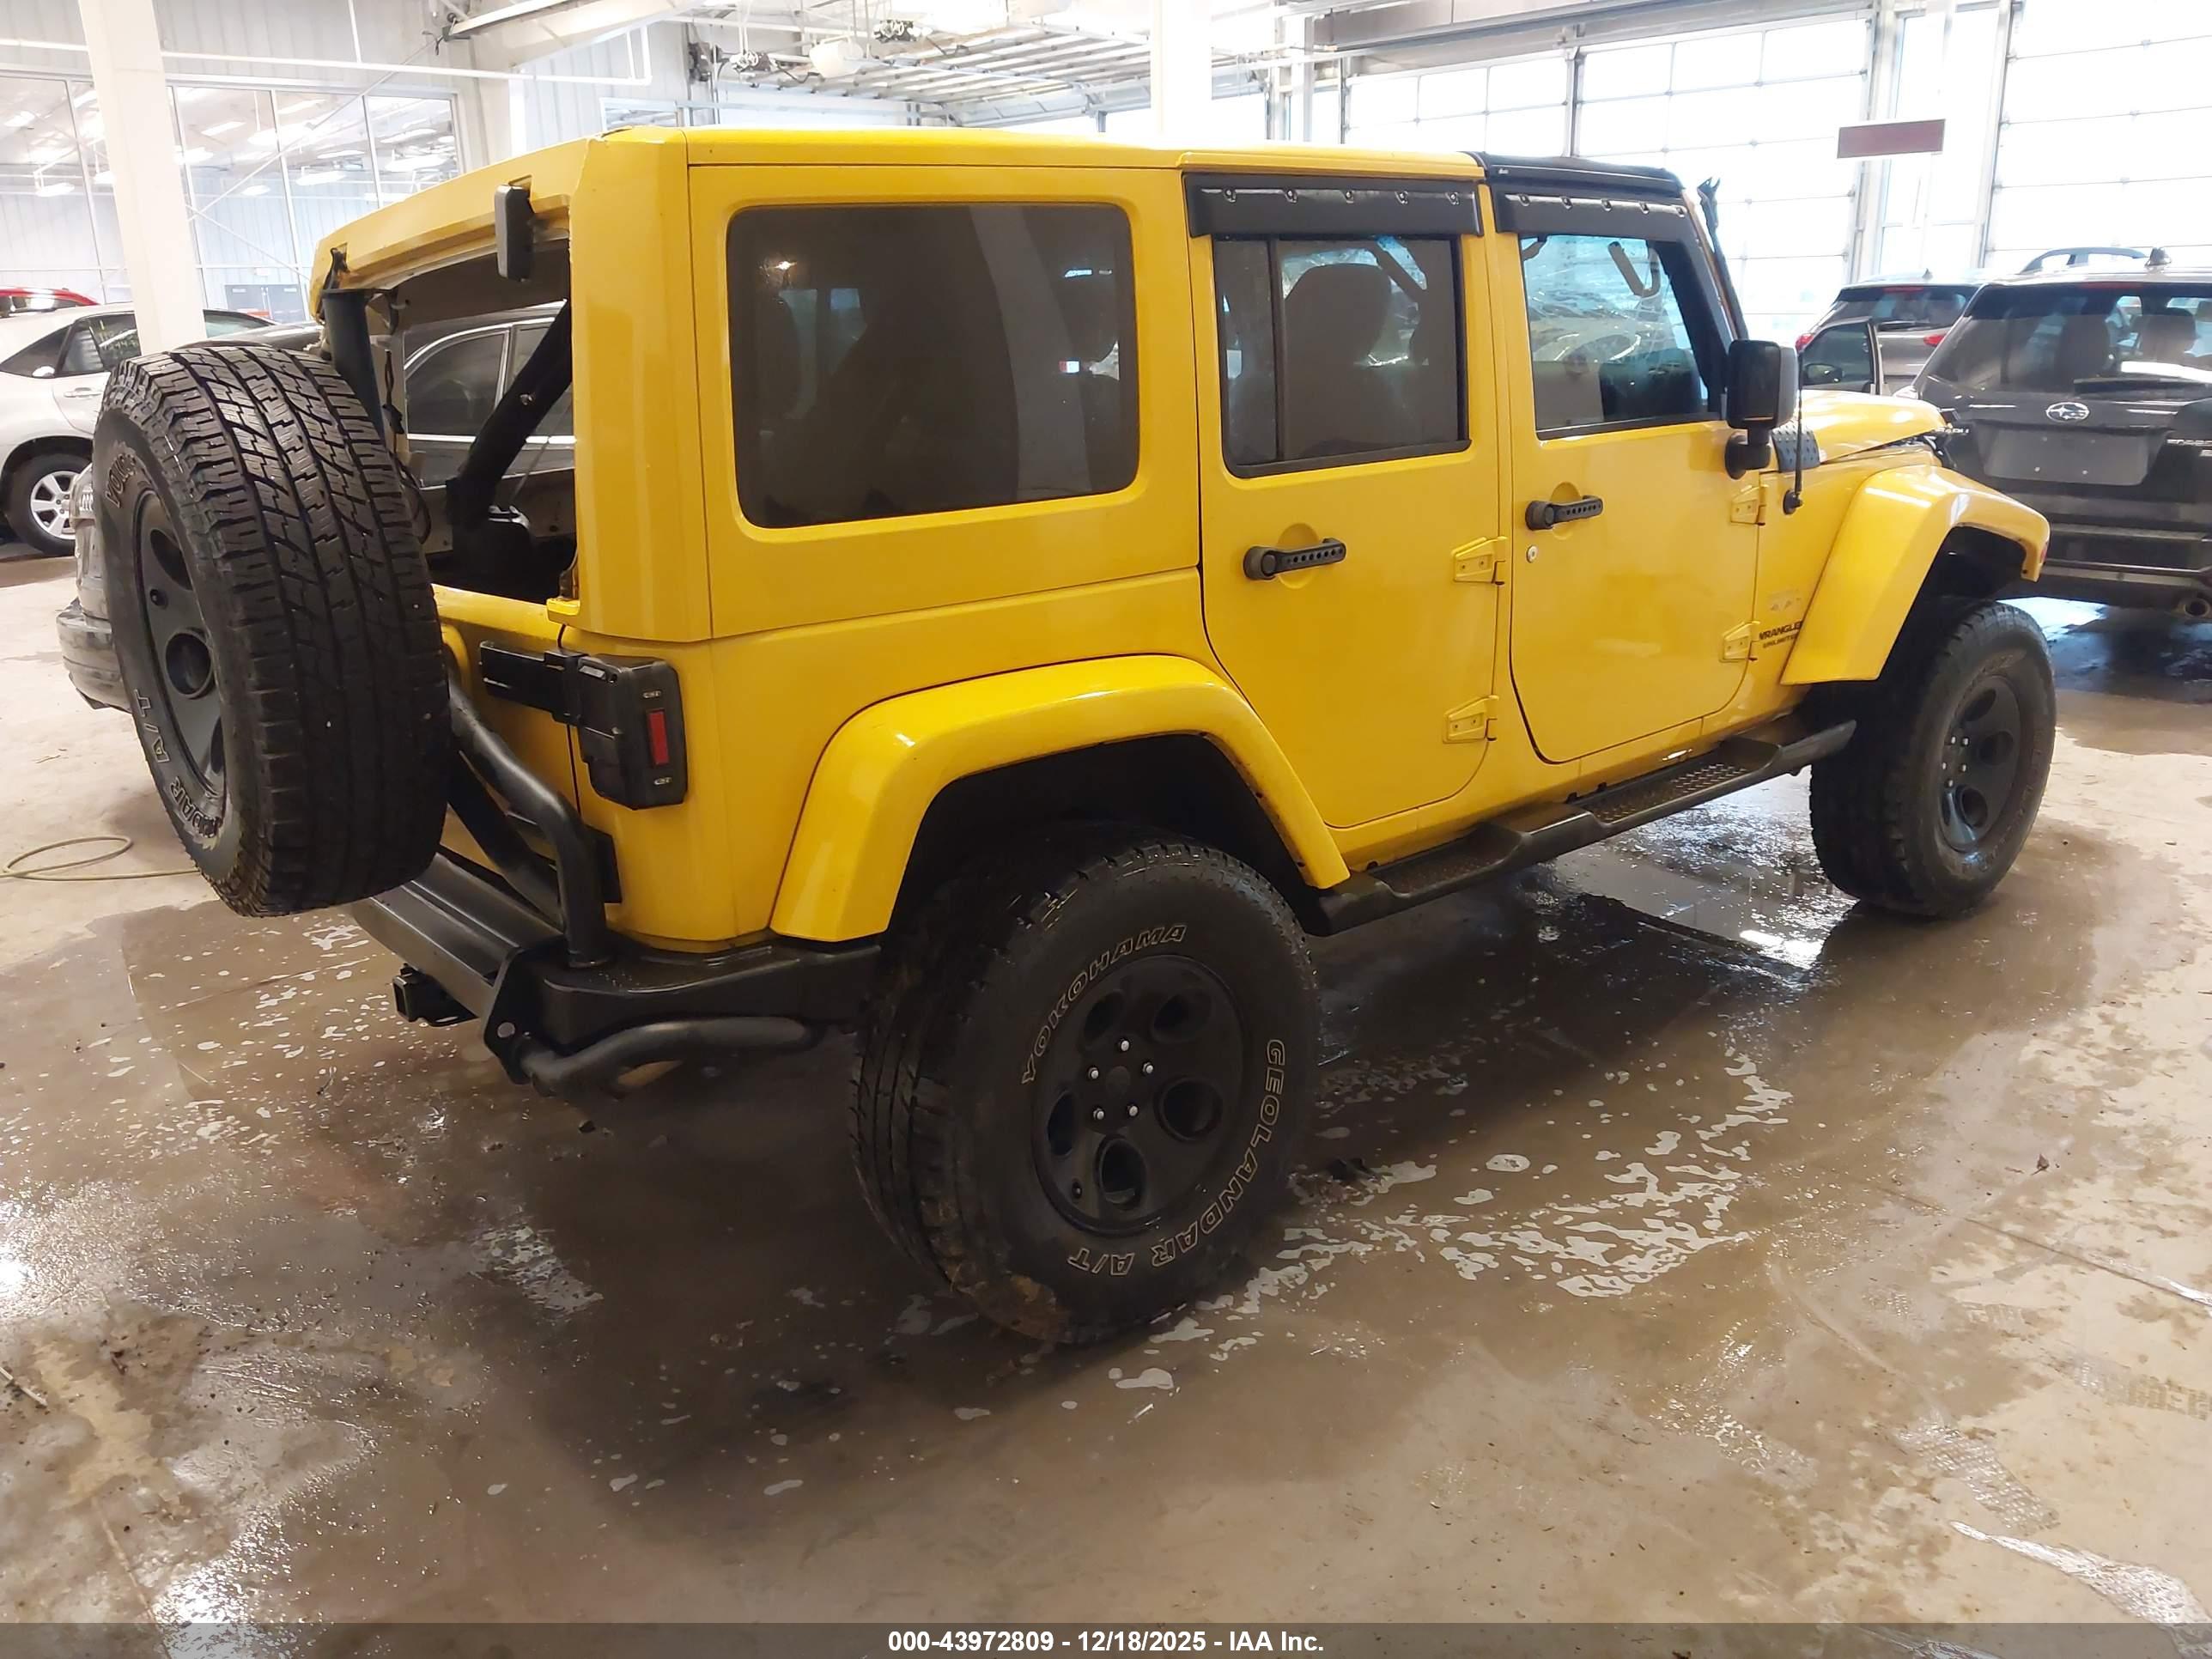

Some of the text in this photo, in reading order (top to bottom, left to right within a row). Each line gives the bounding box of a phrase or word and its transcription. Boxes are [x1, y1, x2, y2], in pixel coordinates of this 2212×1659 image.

[134, 689, 170, 763] A/T
[1020, 924, 1188, 1085] YOKOHAMA
[1066, 1037, 1286, 1277] GEOLANDAR A/T
